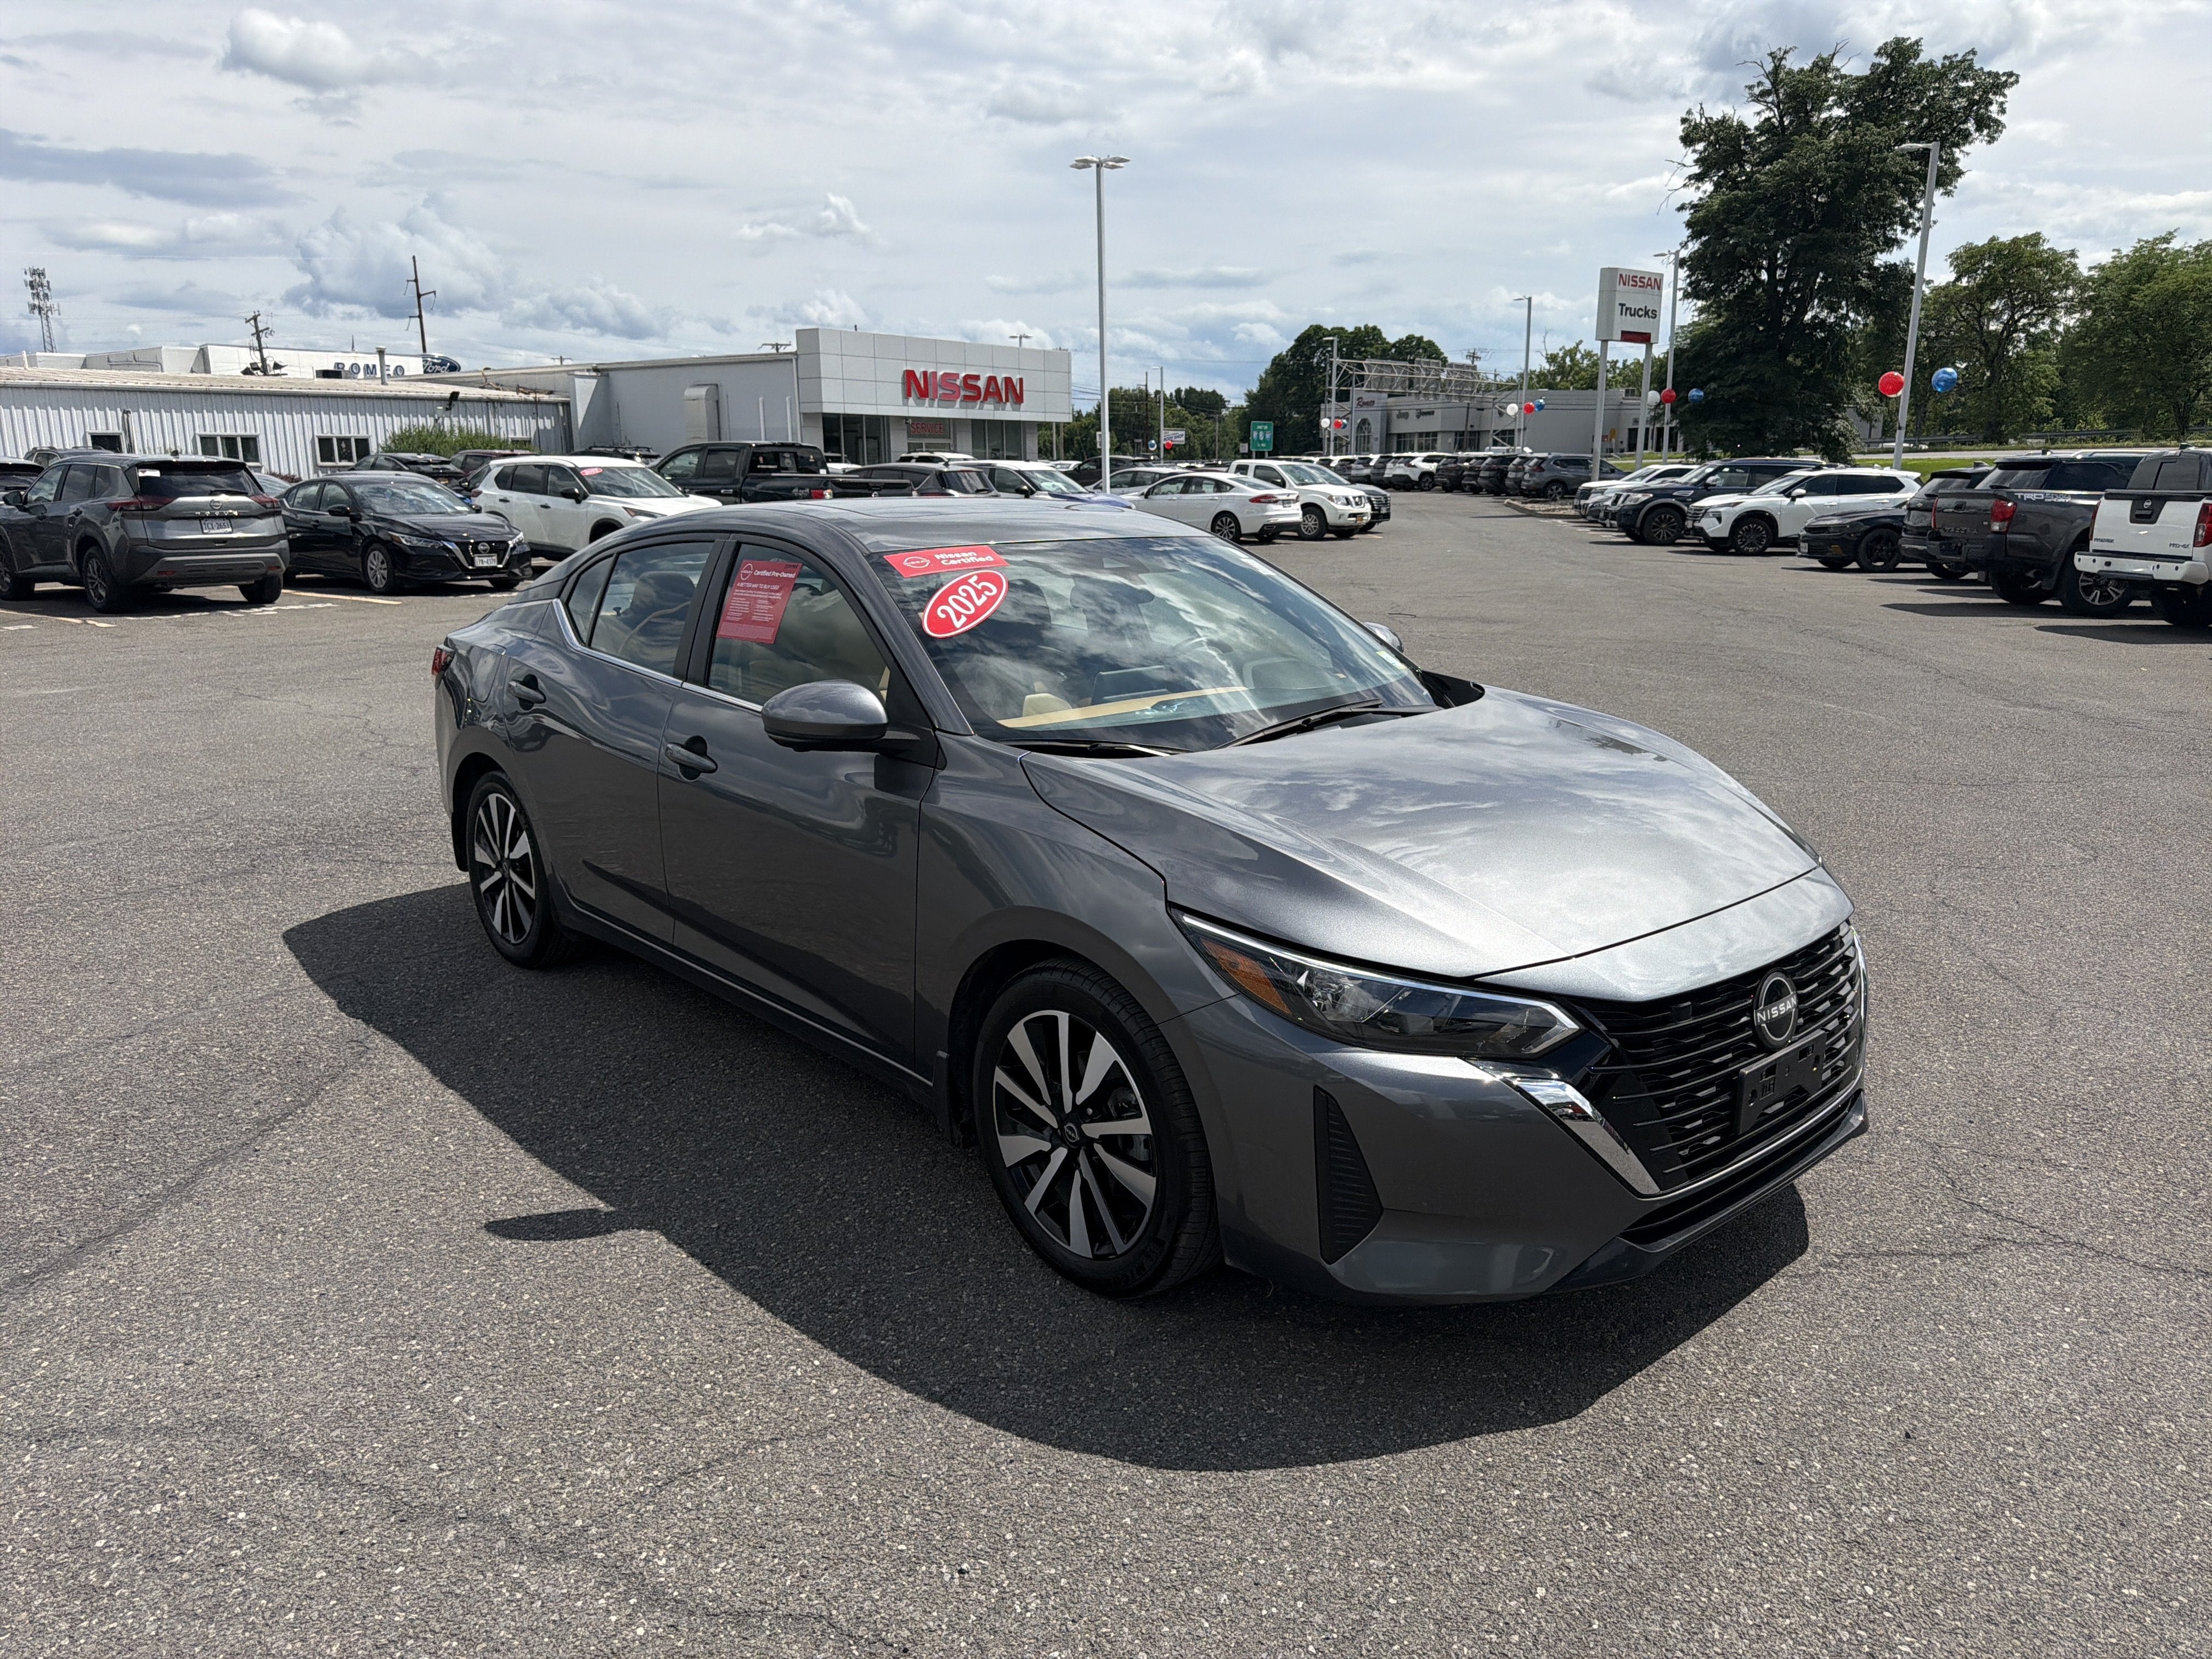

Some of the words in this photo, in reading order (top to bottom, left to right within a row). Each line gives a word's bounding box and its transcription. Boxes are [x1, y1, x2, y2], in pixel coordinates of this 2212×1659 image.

[1618, 273, 1662, 291] NISSAN
[1618, 302, 1657, 319] Trucks
[904, 369, 1024, 404] NISSAN
[910, 422, 944, 435] SERVICE
[934, 551, 977, 560] Nissan
[940, 555, 995, 565] Certified
[936, 575, 998, 629] 2025
[1757, 995, 1797, 1023] NISSAN
